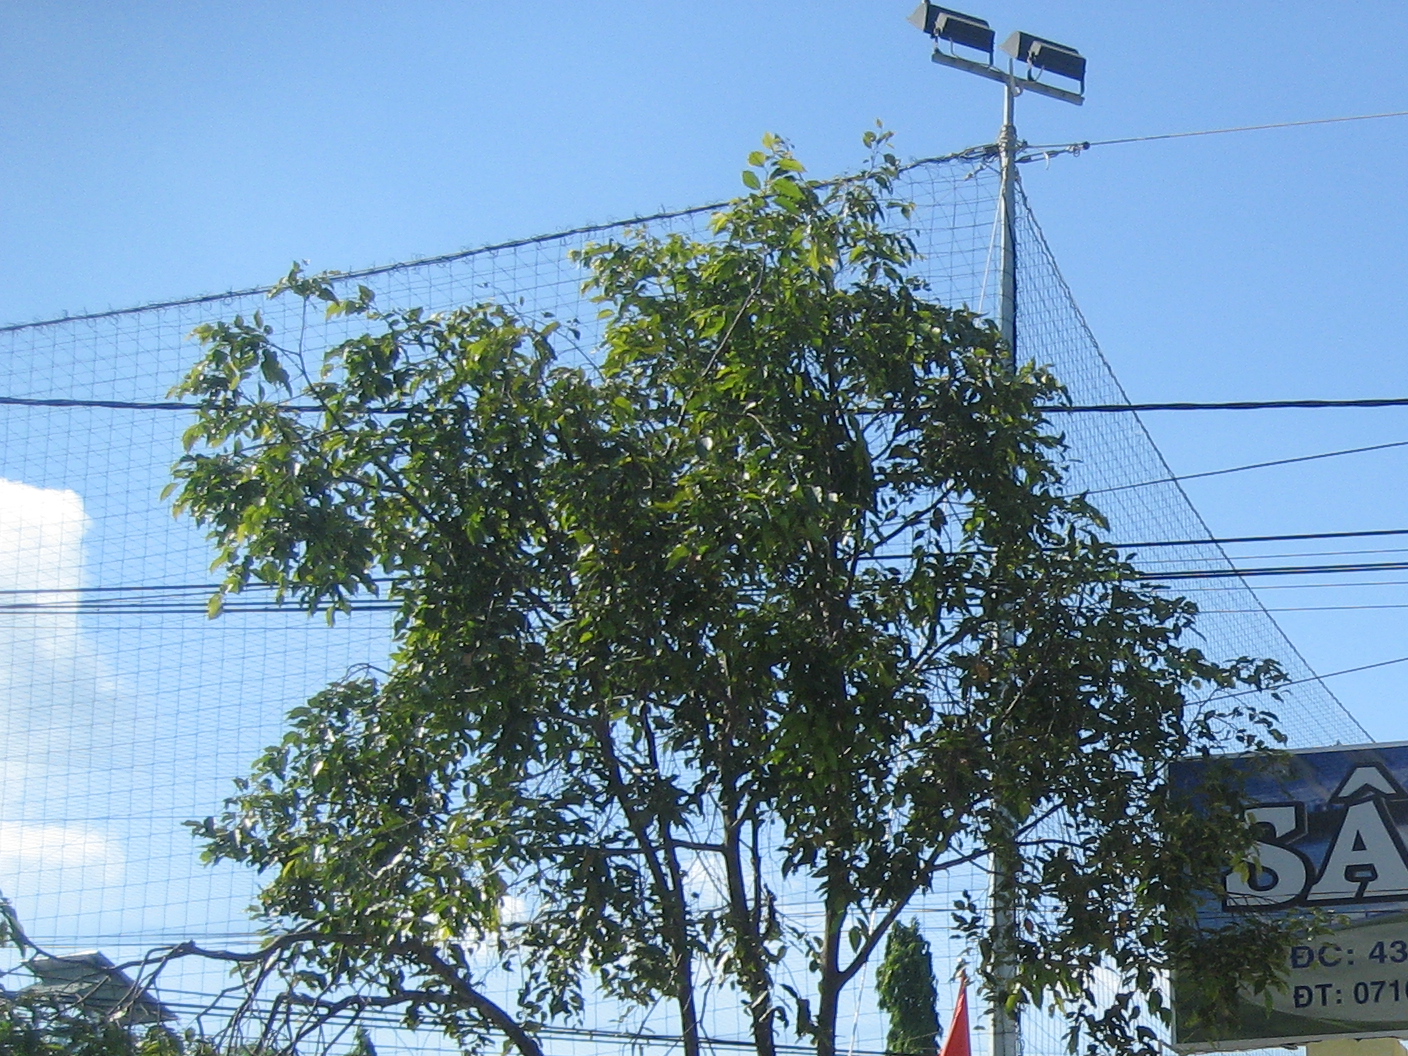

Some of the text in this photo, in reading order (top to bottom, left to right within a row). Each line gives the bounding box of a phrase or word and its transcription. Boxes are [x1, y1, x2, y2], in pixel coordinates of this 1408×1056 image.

[1290, 943, 1355, 969] ĐC:
[1368, 940, 1408, 964] 43
[1293, 983, 1343, 1009] ĐT:
